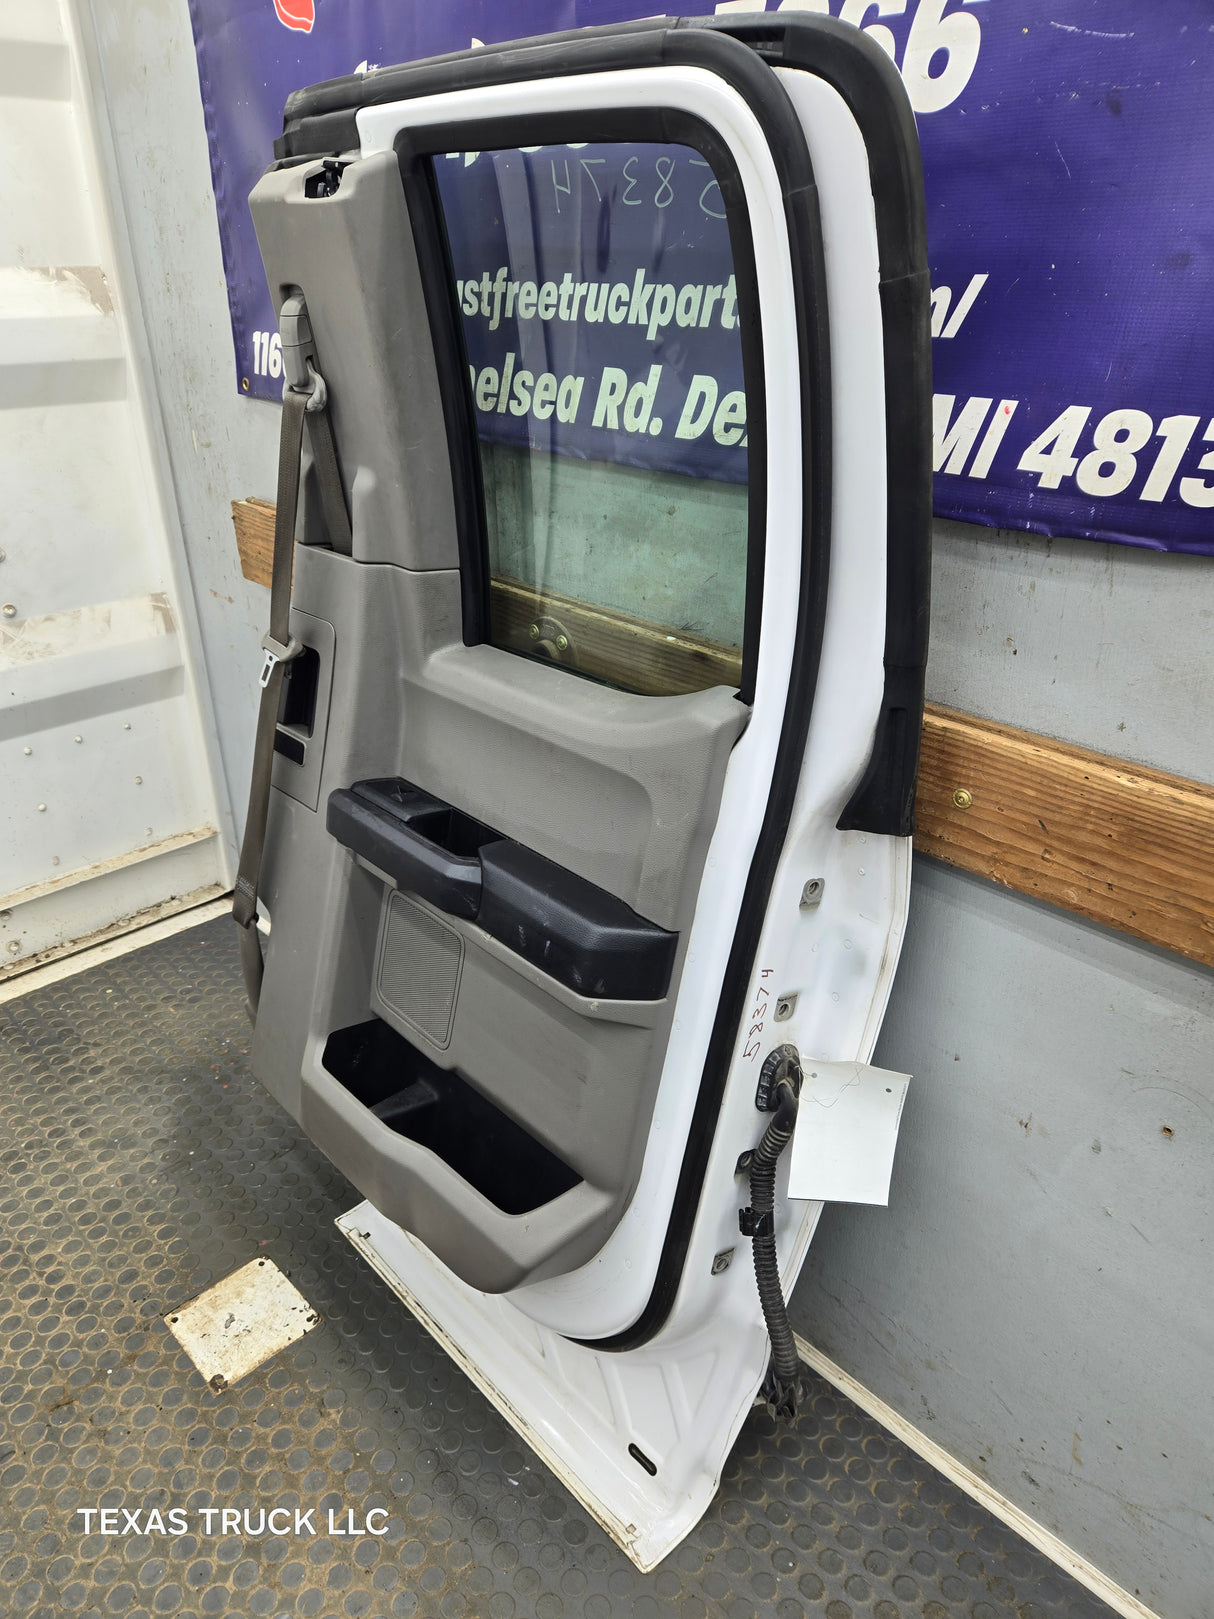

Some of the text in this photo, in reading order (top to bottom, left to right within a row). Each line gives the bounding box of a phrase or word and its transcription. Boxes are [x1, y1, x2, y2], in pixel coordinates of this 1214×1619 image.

[457, 267, 741, 341] stfreetruckpart
[253, 331, 288, 378] 116
[468, 352, 585, 424] elsea
[592, 364, 663, 436] Rd.
[675, 374, 748, 448] De
[932, 393, 1020, 479] MI
[743, 968, 774, 1062] 58374
